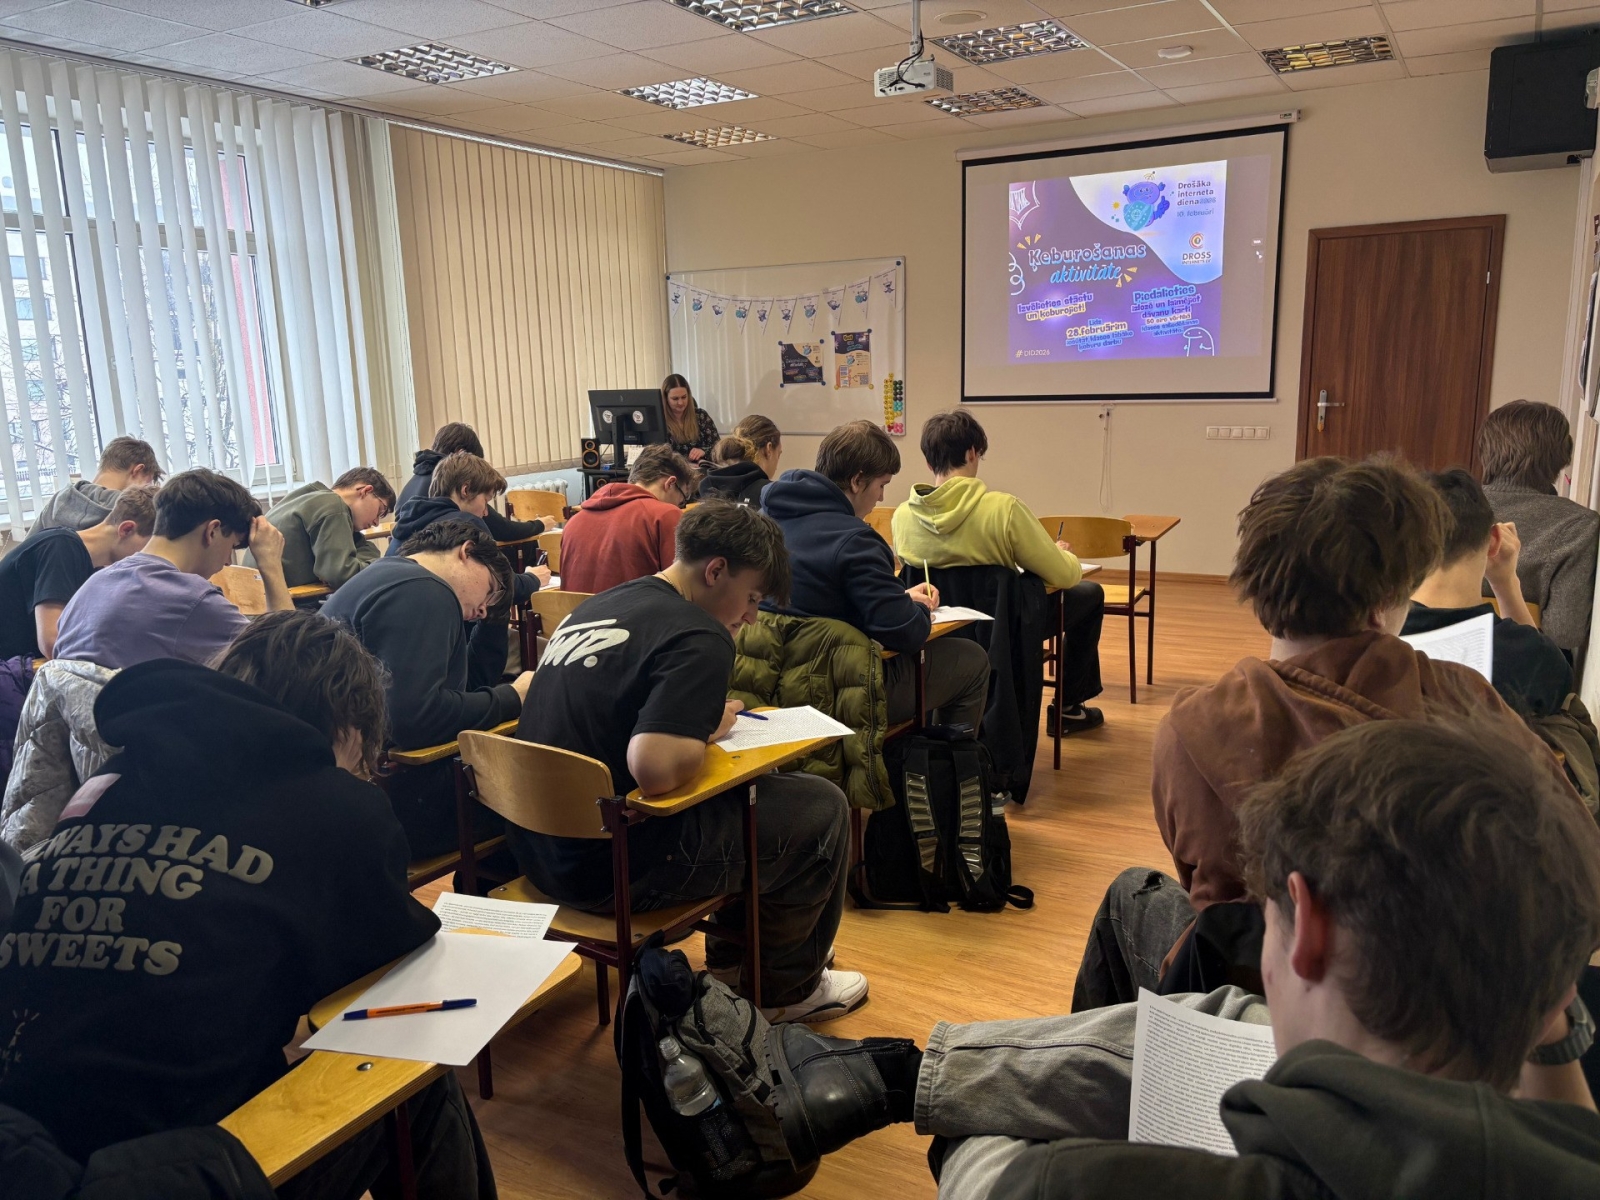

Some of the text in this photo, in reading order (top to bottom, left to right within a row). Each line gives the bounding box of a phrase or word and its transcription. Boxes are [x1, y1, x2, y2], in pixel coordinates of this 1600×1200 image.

[1177, 189, 1214, 198] interneta
[1178, 180, 1211, 190] Drošāka
[1177, 198, 1200, 206] diena
[1028, 242, 1147, 272] Ķeburošanas
[1182, 251, 1212, 261] DROSS
[1050, 262, 1123, 284] aktivitāte
[1026, 312, 1038, 320] un
[147, 824, 274, 885] HAD
[20, 856, 204, 900] A THING
[34, 895, 127, 933] FOR
[0, 932, 183, 976] SWEETS
